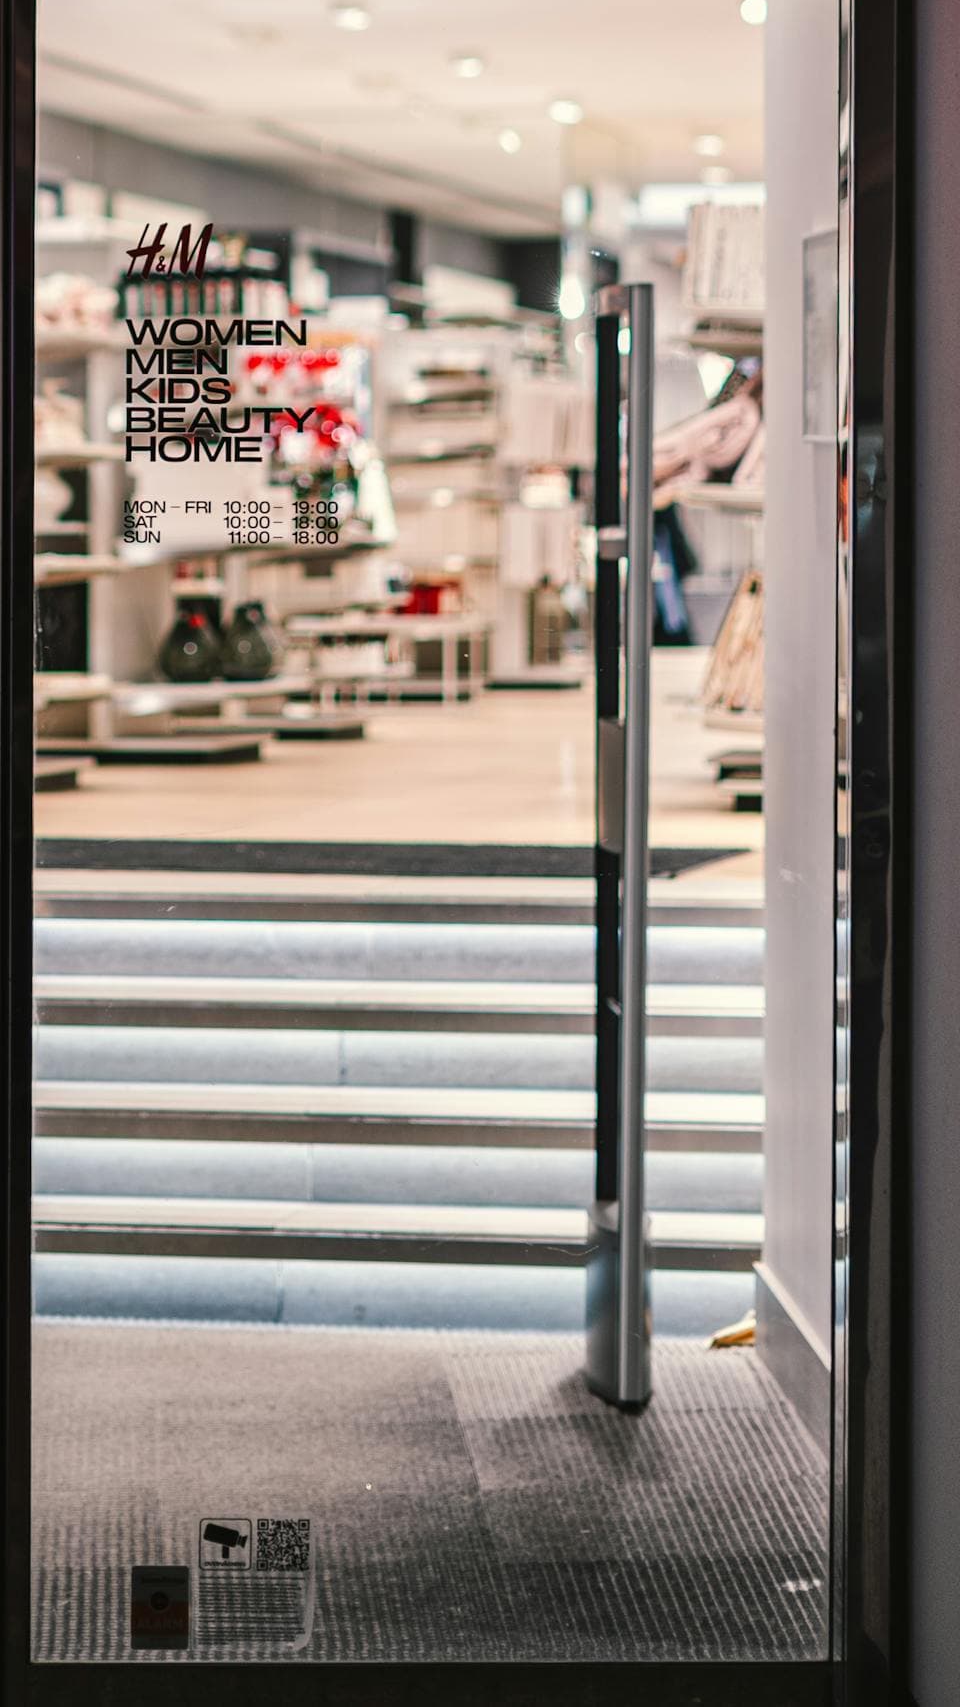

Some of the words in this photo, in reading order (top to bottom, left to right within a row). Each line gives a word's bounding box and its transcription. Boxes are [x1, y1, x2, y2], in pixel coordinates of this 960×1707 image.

[126, 222, 214, 280] H&M
[125, 318, 308, 346] WOMEN
[126, 349, 228, 375] MEN
[126, 377, 232, 404] KIDS
[125, 407, 318, 433] BEAUTY
[125, 436, 263, 463] HOME
[123, 500, 166, 514] MON
[185, 500, 212, 514] FRI
[292, 501, 339, 514] 19:00
[123, 515, 158, 529] SAT
[292, 516, 339, 529] 18:00
[123, 530, 161, 544] SUN
[292, 531, 339, 544] 18:00
